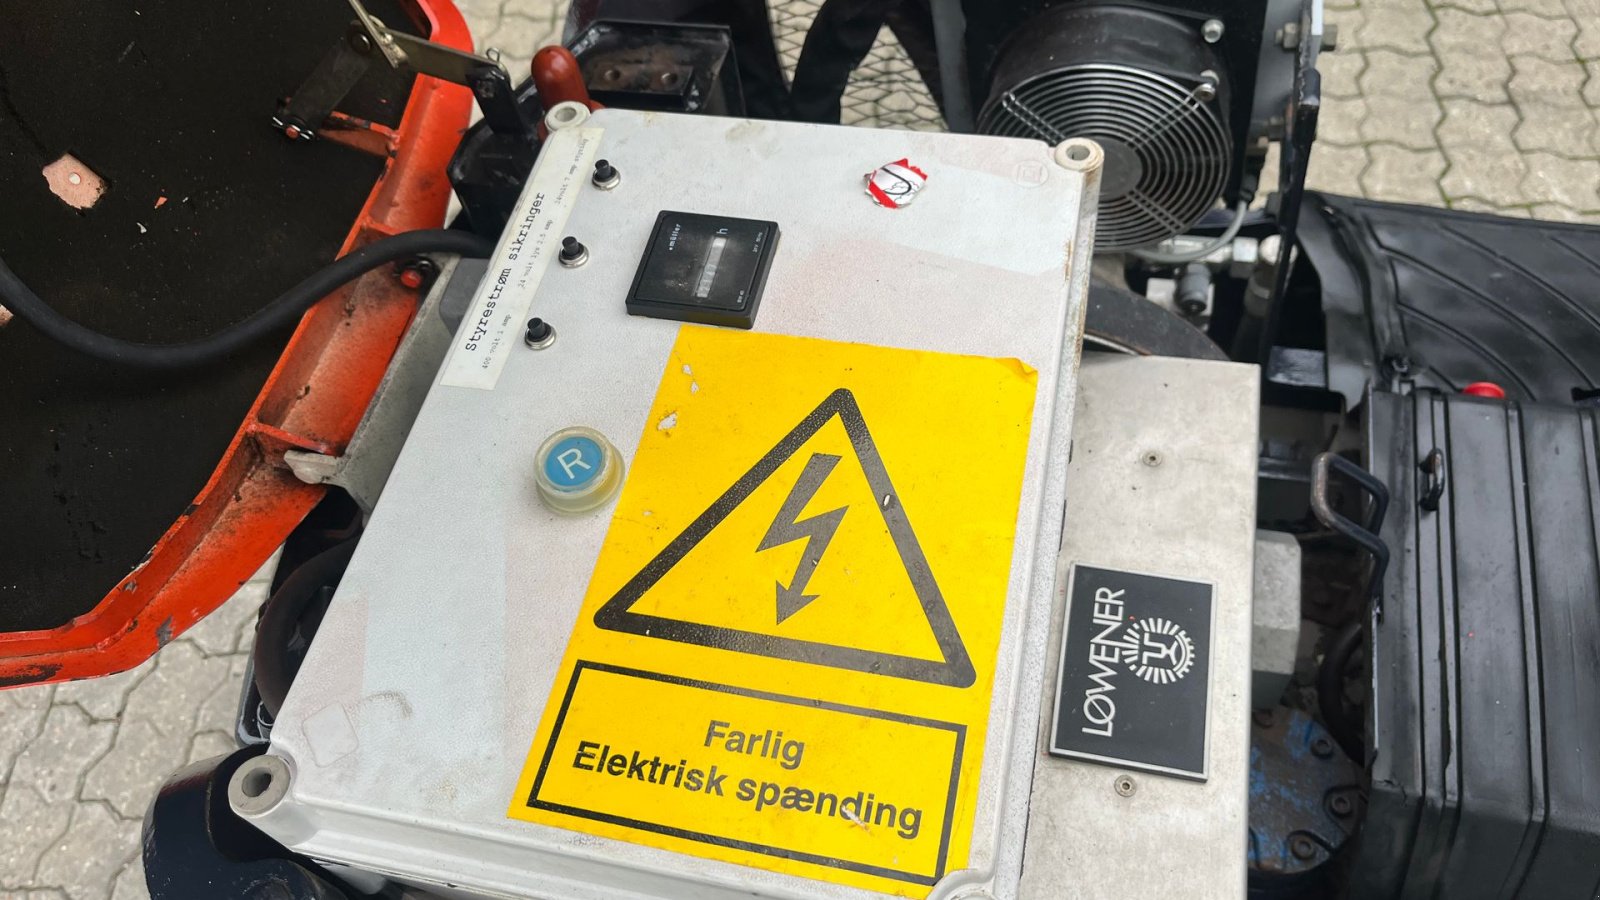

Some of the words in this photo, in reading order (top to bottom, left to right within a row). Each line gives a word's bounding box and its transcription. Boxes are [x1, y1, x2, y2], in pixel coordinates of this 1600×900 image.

[465, 268, 512, 351] Styrestrøm
[508, 192, 545, 260] sikringer
[524, 261, 533, 277] volt
[489, 337, 501, 354] volt
[502, 314, 512, 327] amp
[557, 448, 592, 480] R
[1081, 587, 1126, 737] LØWENER
[703, 719, 806, 770] Farlig
[572, 740, 729, 797] Elektrisk
[735, 777, 924, 840] spænding
